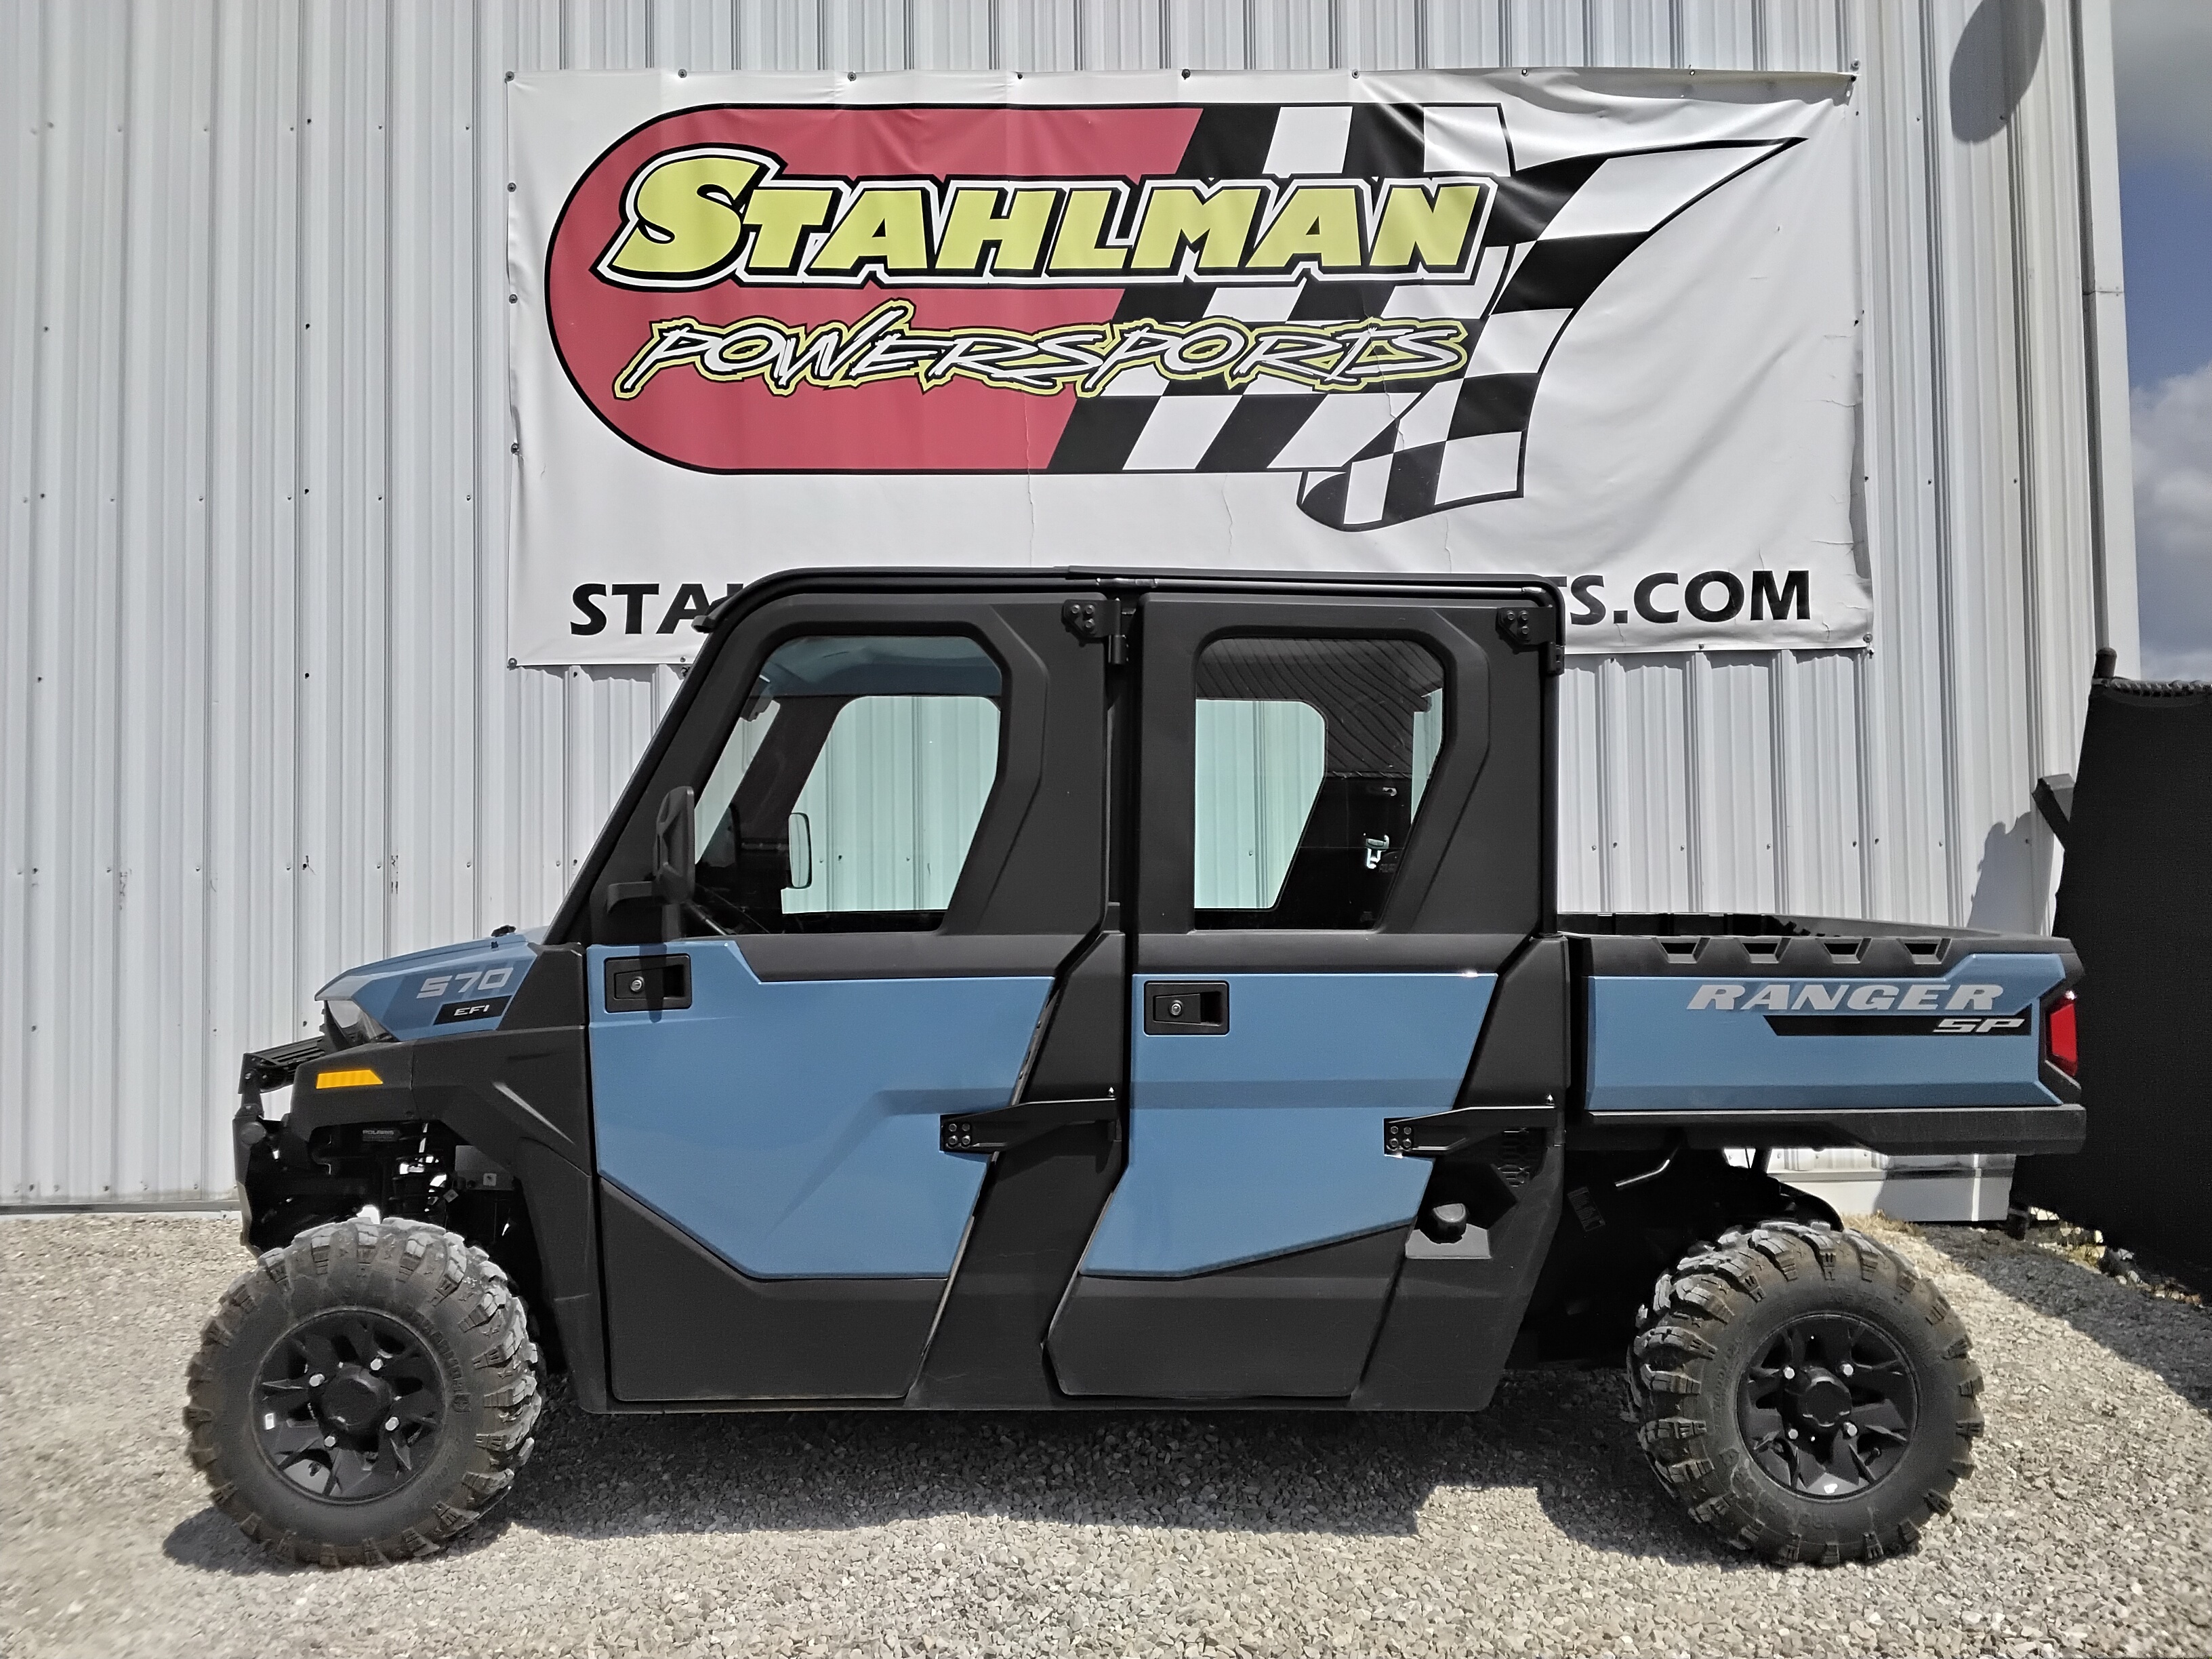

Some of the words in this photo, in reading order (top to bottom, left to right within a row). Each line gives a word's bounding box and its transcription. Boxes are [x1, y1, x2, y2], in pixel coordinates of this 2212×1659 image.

[598, 146, 1495, 285] STAHLMAN
[615, 301, 1468, 397] POWERSPORTS
[418, 968, 512, 999] 570
[1687, 985, 2003, 1010] RANGER
[453, 1005, 489, 1017] EFI
[1933, 1019, 2024, 1033] SP
